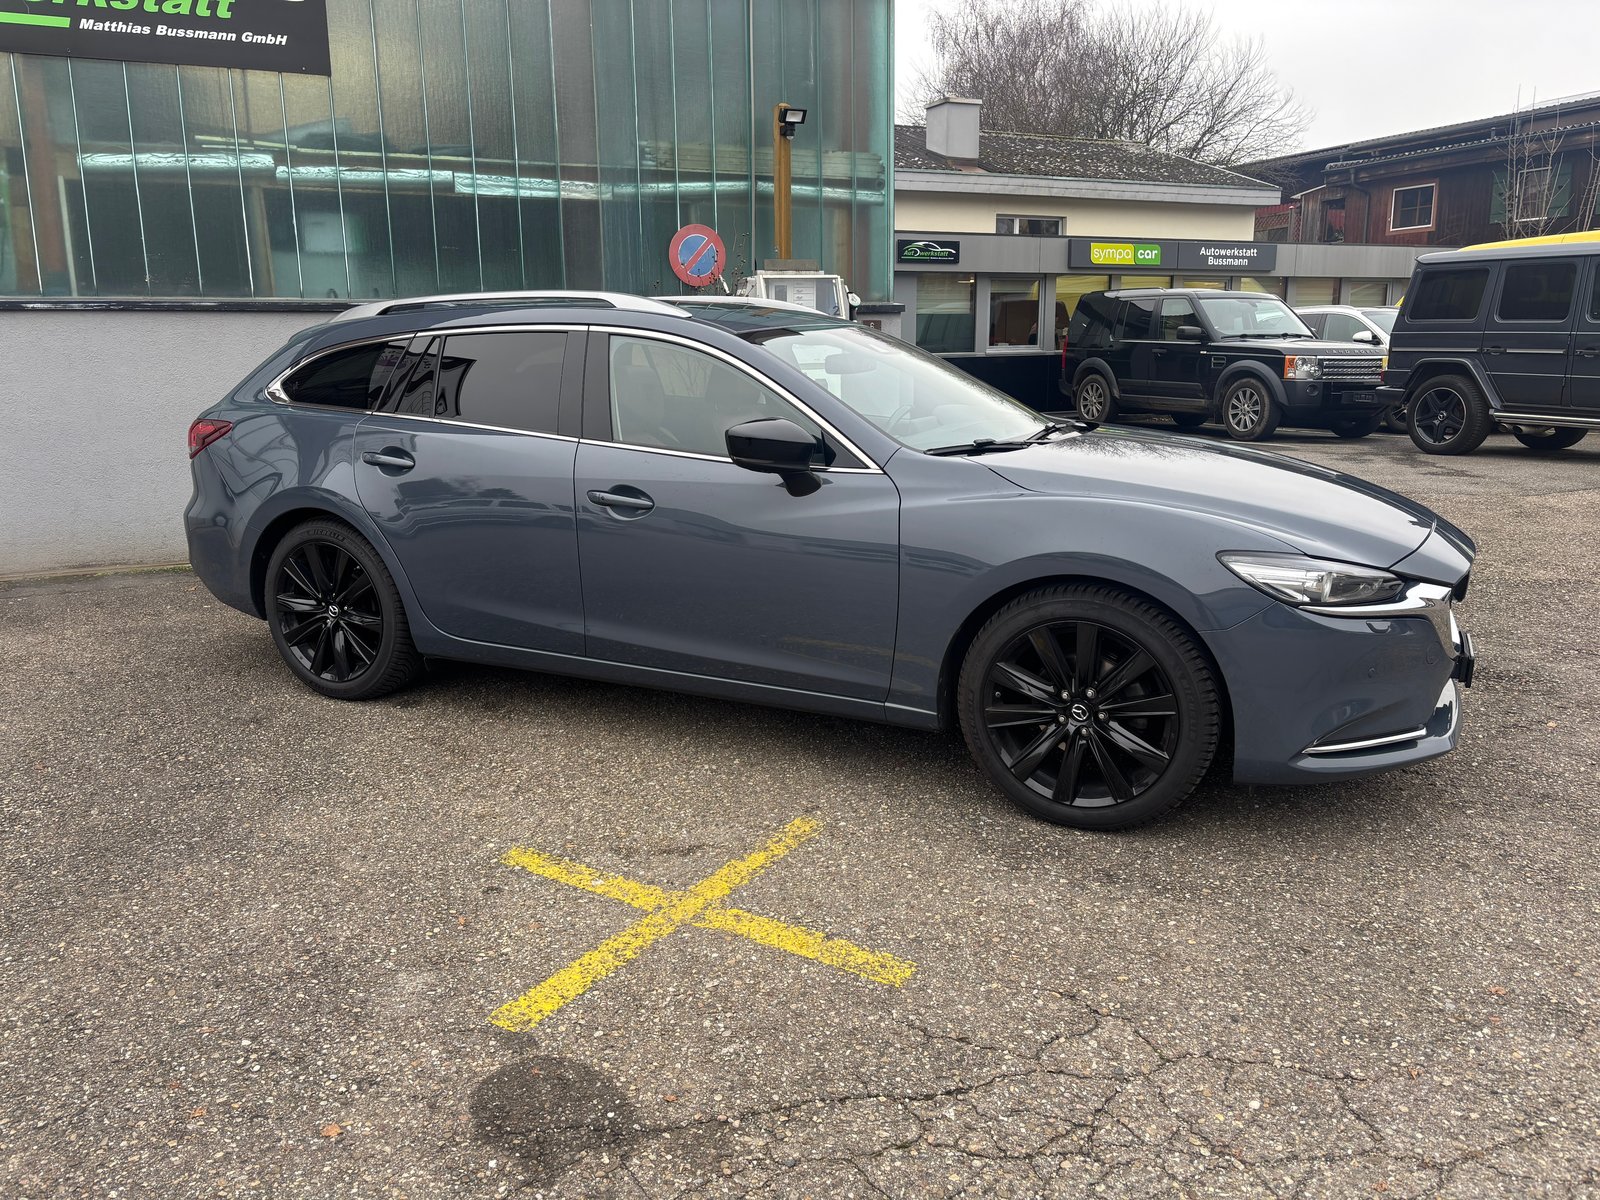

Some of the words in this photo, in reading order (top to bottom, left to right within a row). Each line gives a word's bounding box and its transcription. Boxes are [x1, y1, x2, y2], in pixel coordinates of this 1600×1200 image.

[79, 18, 151, 35] Matthias
[155, 24, 237, 42] Bussmann
[241, 31, 288, 46] GmbH
[1093, 247, 1132, 261] sympa
[1137, 249, 1158, 259] car
[1199, 246, 1258, 257] Autowerkstatt
[1208, 257, 1248, 266] Bussmann
